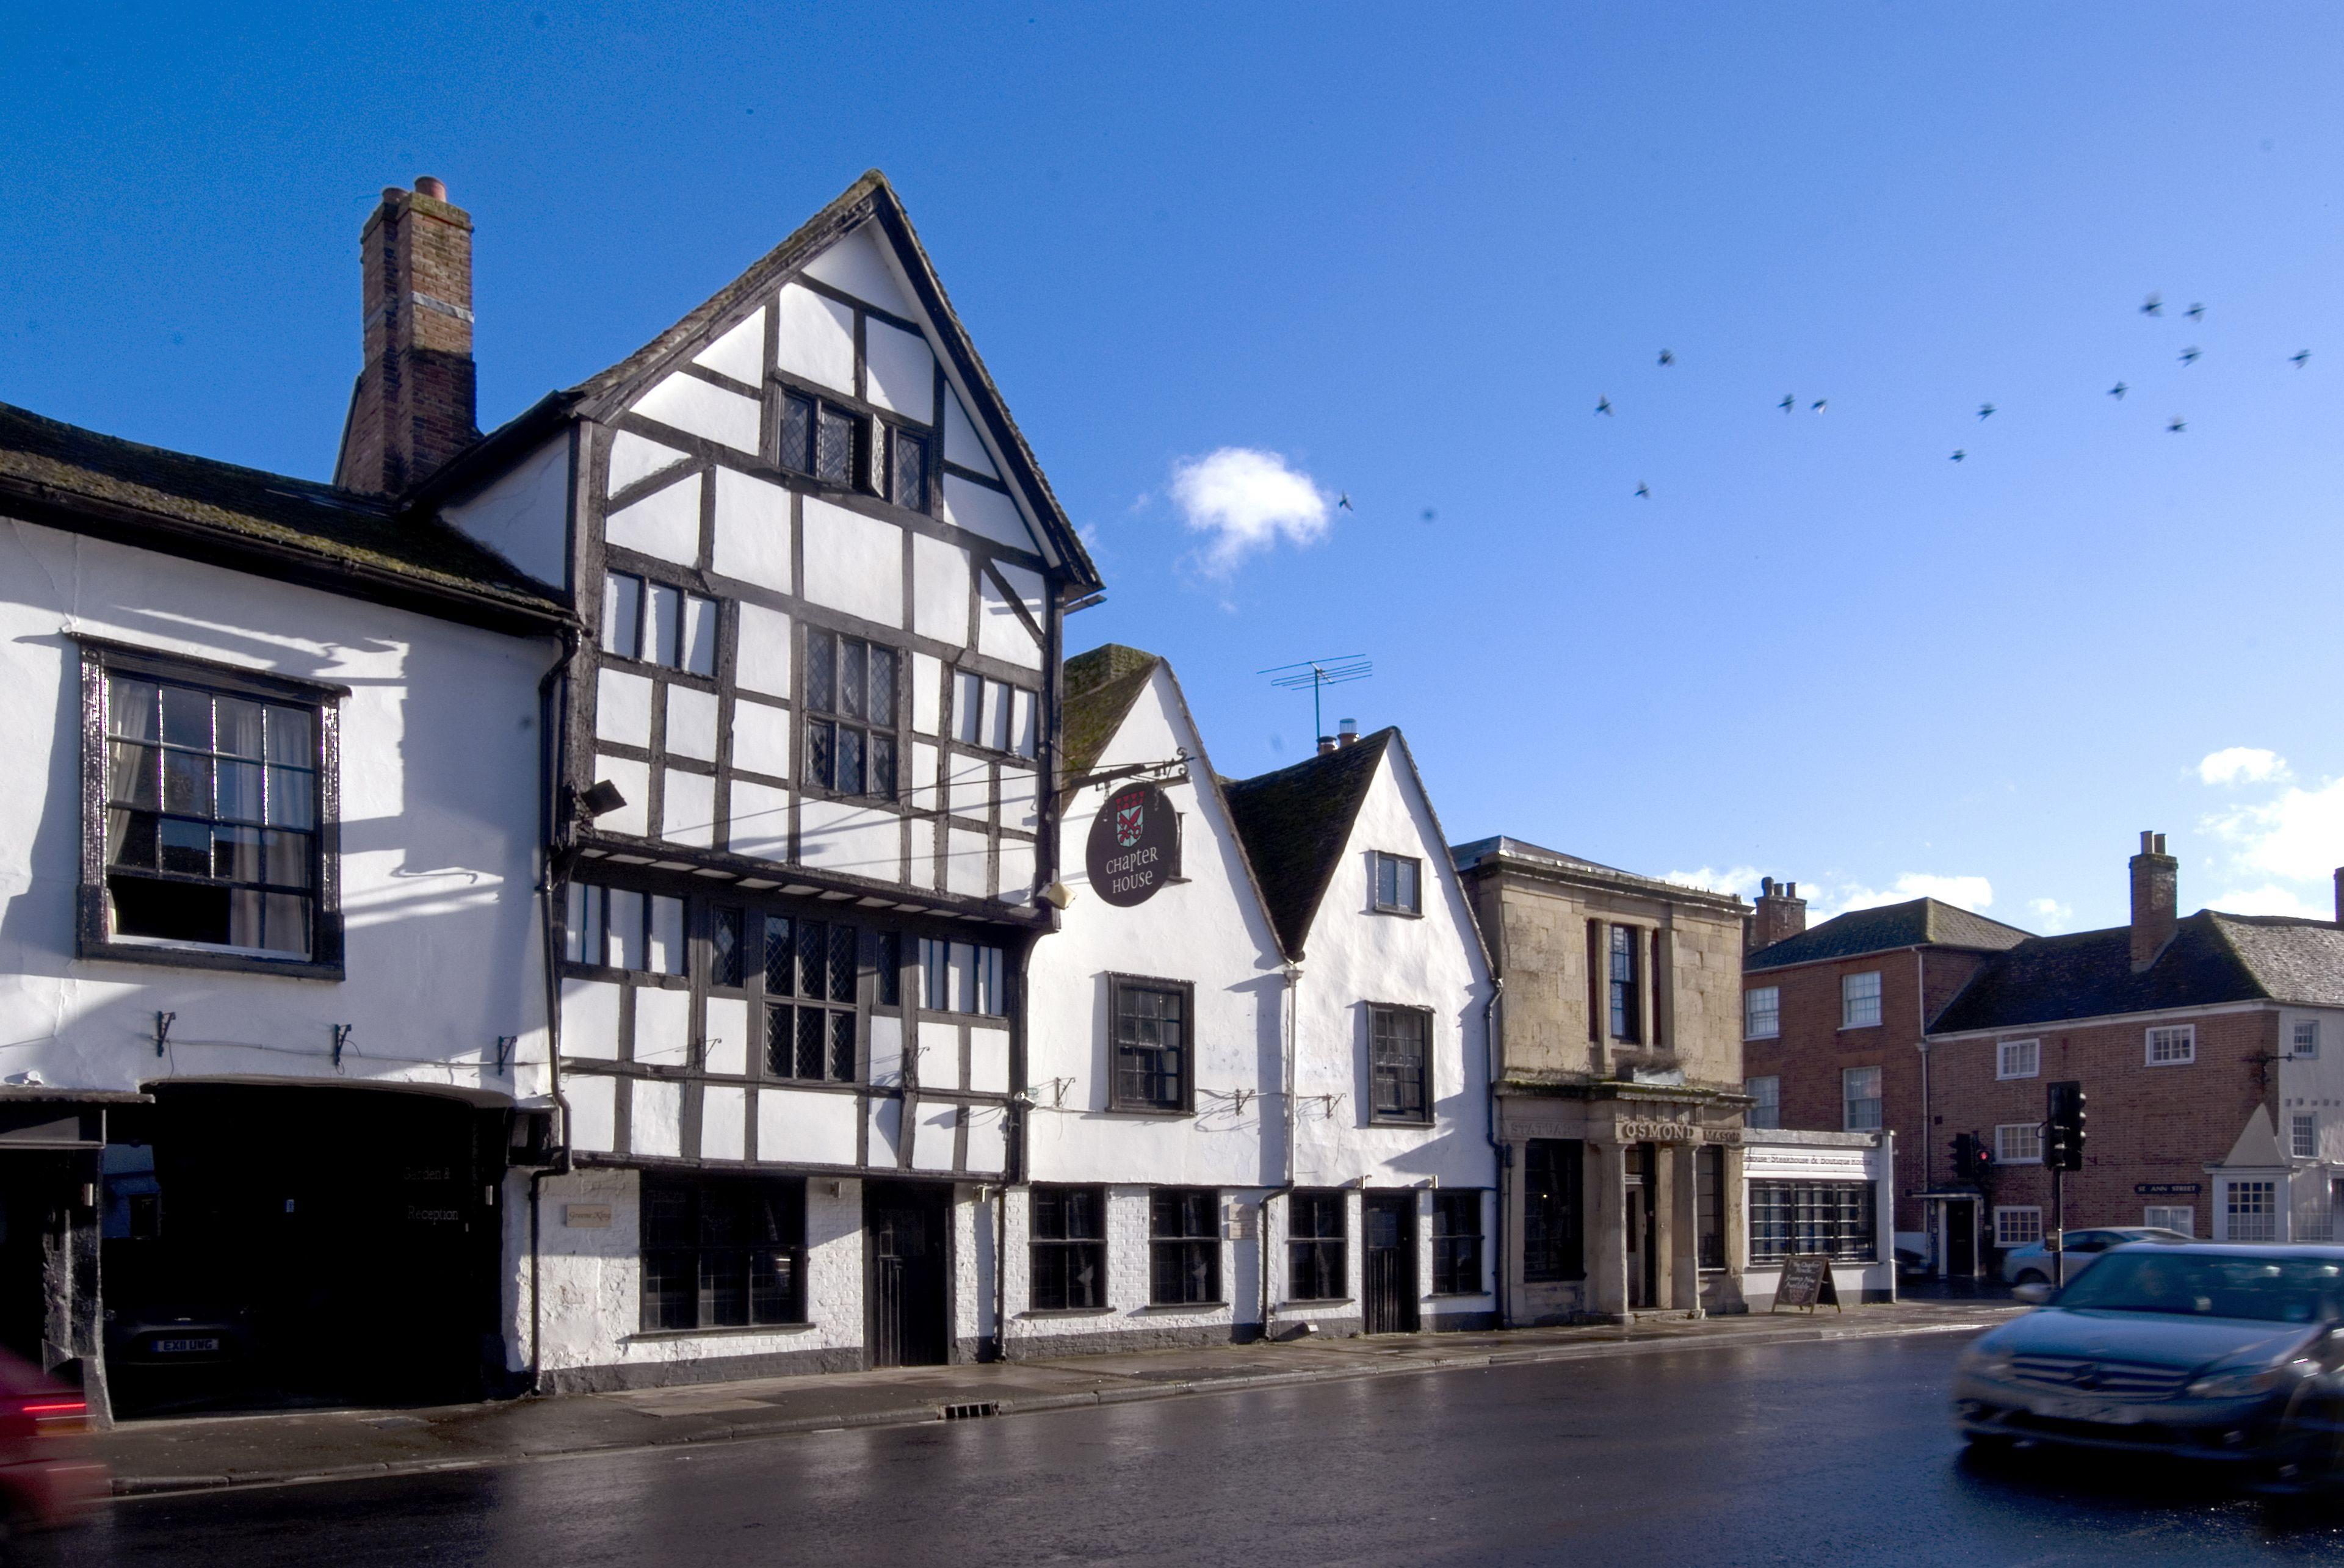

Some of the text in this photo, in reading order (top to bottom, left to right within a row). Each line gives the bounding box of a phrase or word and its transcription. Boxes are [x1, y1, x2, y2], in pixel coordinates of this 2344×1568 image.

[1626, 1124, 1696, 1140] OSMOND
[1706, 1130, 1741, 1143] MASON
[403, 1166, 450, 1180] Garden &
[408, 1206, 458, 1225] Reception
